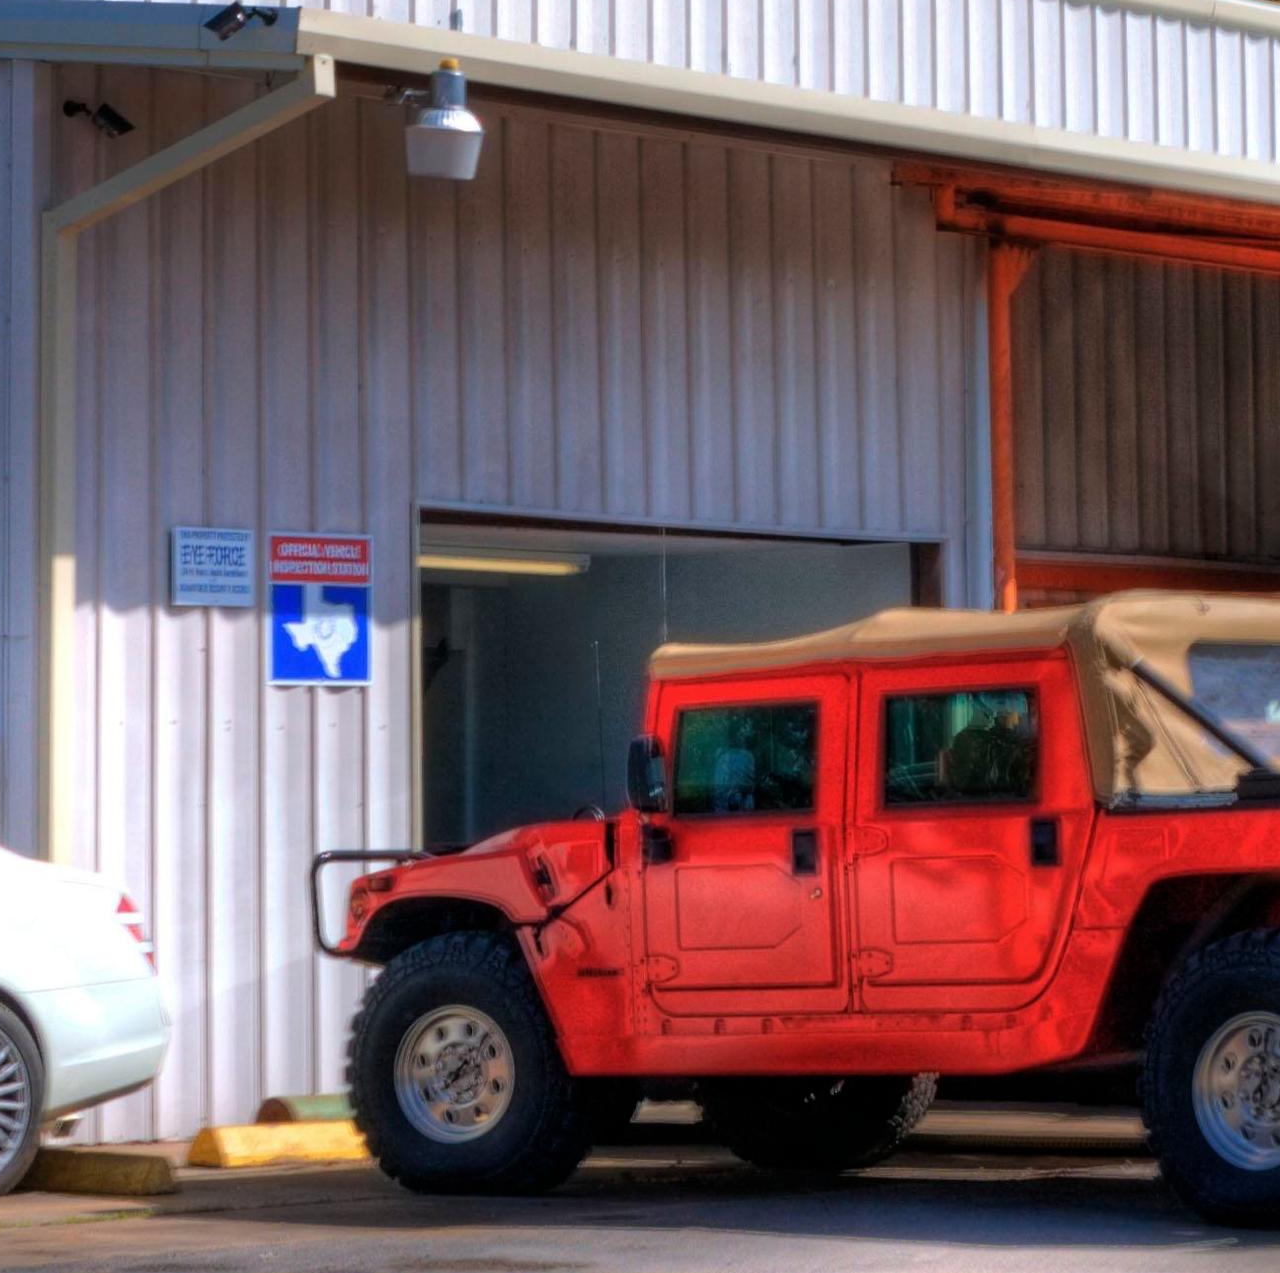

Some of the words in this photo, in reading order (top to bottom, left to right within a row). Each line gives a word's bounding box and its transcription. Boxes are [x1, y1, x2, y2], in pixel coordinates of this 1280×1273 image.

[181, 544, 206, 566] EYE
[207, 544, 247, 567] FORCE
[278, 541, 322, 557] OFFICIAL
[323, 543, 362, 560] VEHICLE
[271, 559, 327, 575] INSPECTION
[327, 561, 369, 577] STATION
